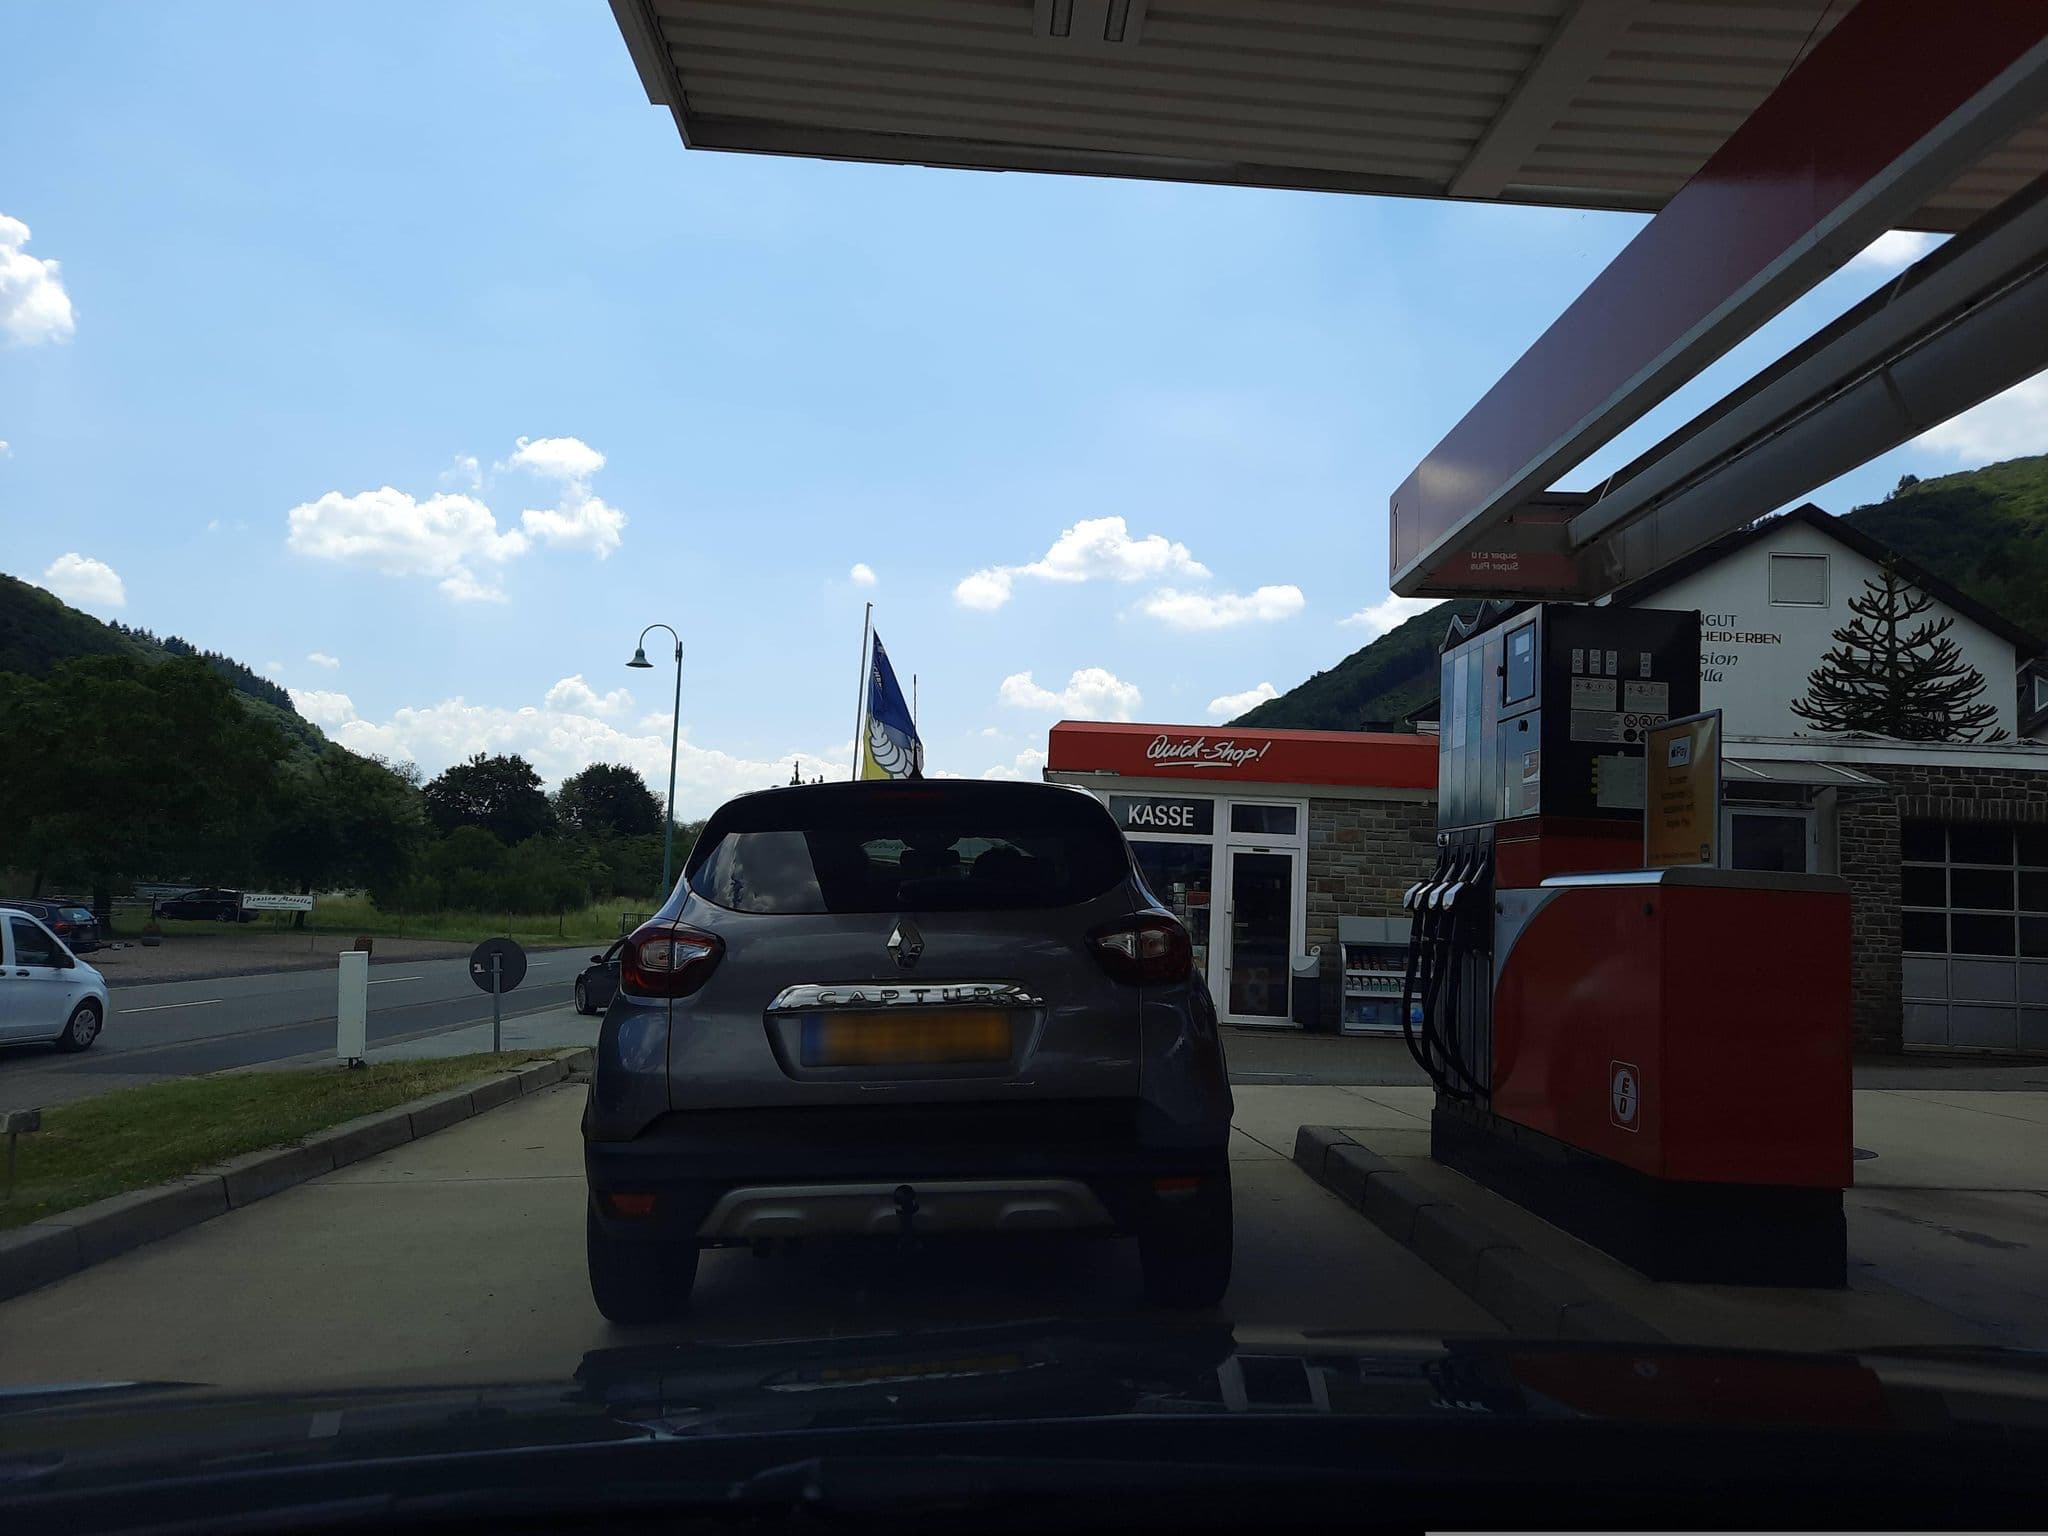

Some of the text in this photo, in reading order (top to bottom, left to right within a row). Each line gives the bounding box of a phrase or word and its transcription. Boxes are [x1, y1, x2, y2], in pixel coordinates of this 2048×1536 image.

[1146, 734, 1272, 767] Quick-Shop!
[1128, 803, 1194, 827] KASSE
[816, 987, 994, 1004] CAPTUR
